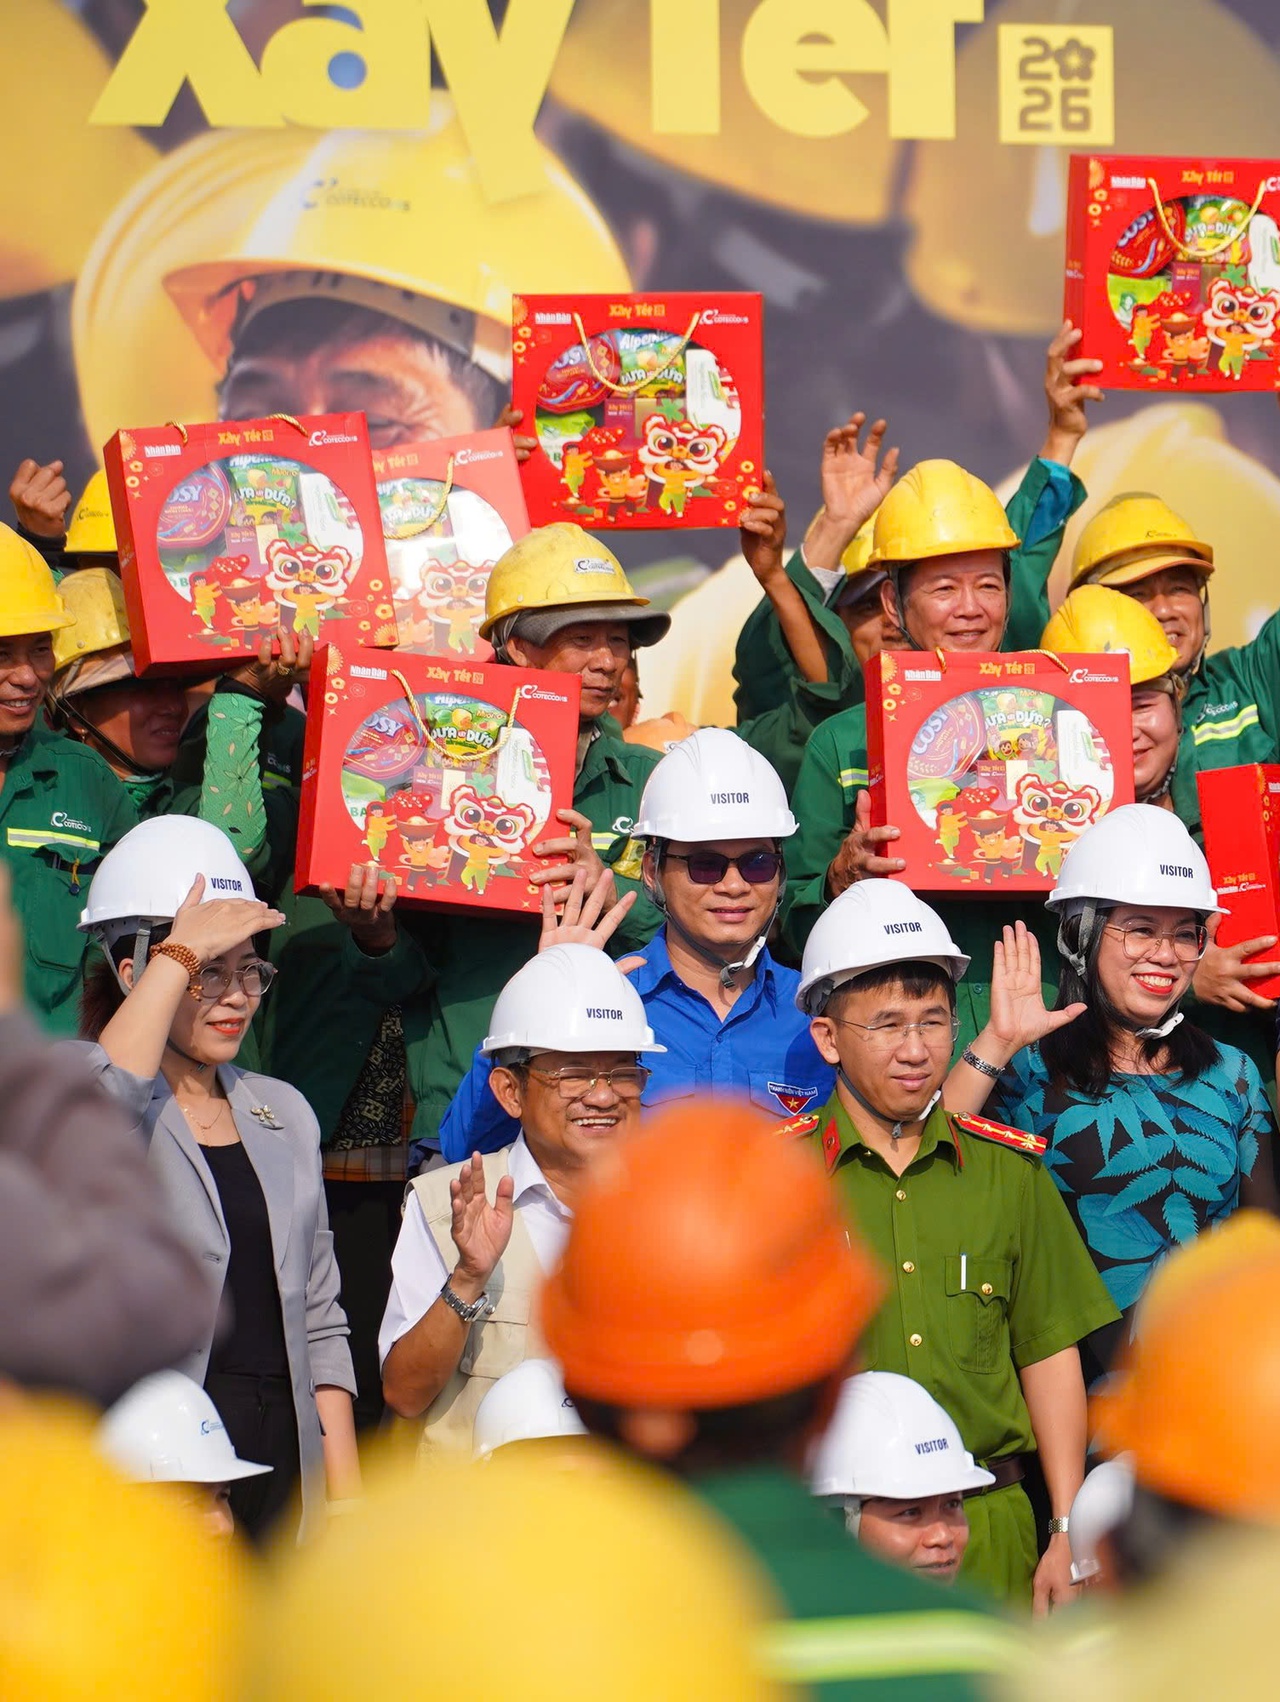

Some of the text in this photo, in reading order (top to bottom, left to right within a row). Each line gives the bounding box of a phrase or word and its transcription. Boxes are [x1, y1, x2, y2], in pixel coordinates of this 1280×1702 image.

[218, 429, 261, 445] Xây Tết
[427, 667, 473, 683] Xây Tết
[980, 661, 1023, 677] Xây Tết
[364, 713, 404, 737] OSY
[711, 792, 750, 804] VISITOR
[1159, 864, 1193, 879] VISITOR
[211, 877, 242, 892] VISITOR
[884, 921, 922, 935] VISITOR
[586, 1008, 623, 1020] VISITOR
[914, 1437, 949, 1455] VISITOR
